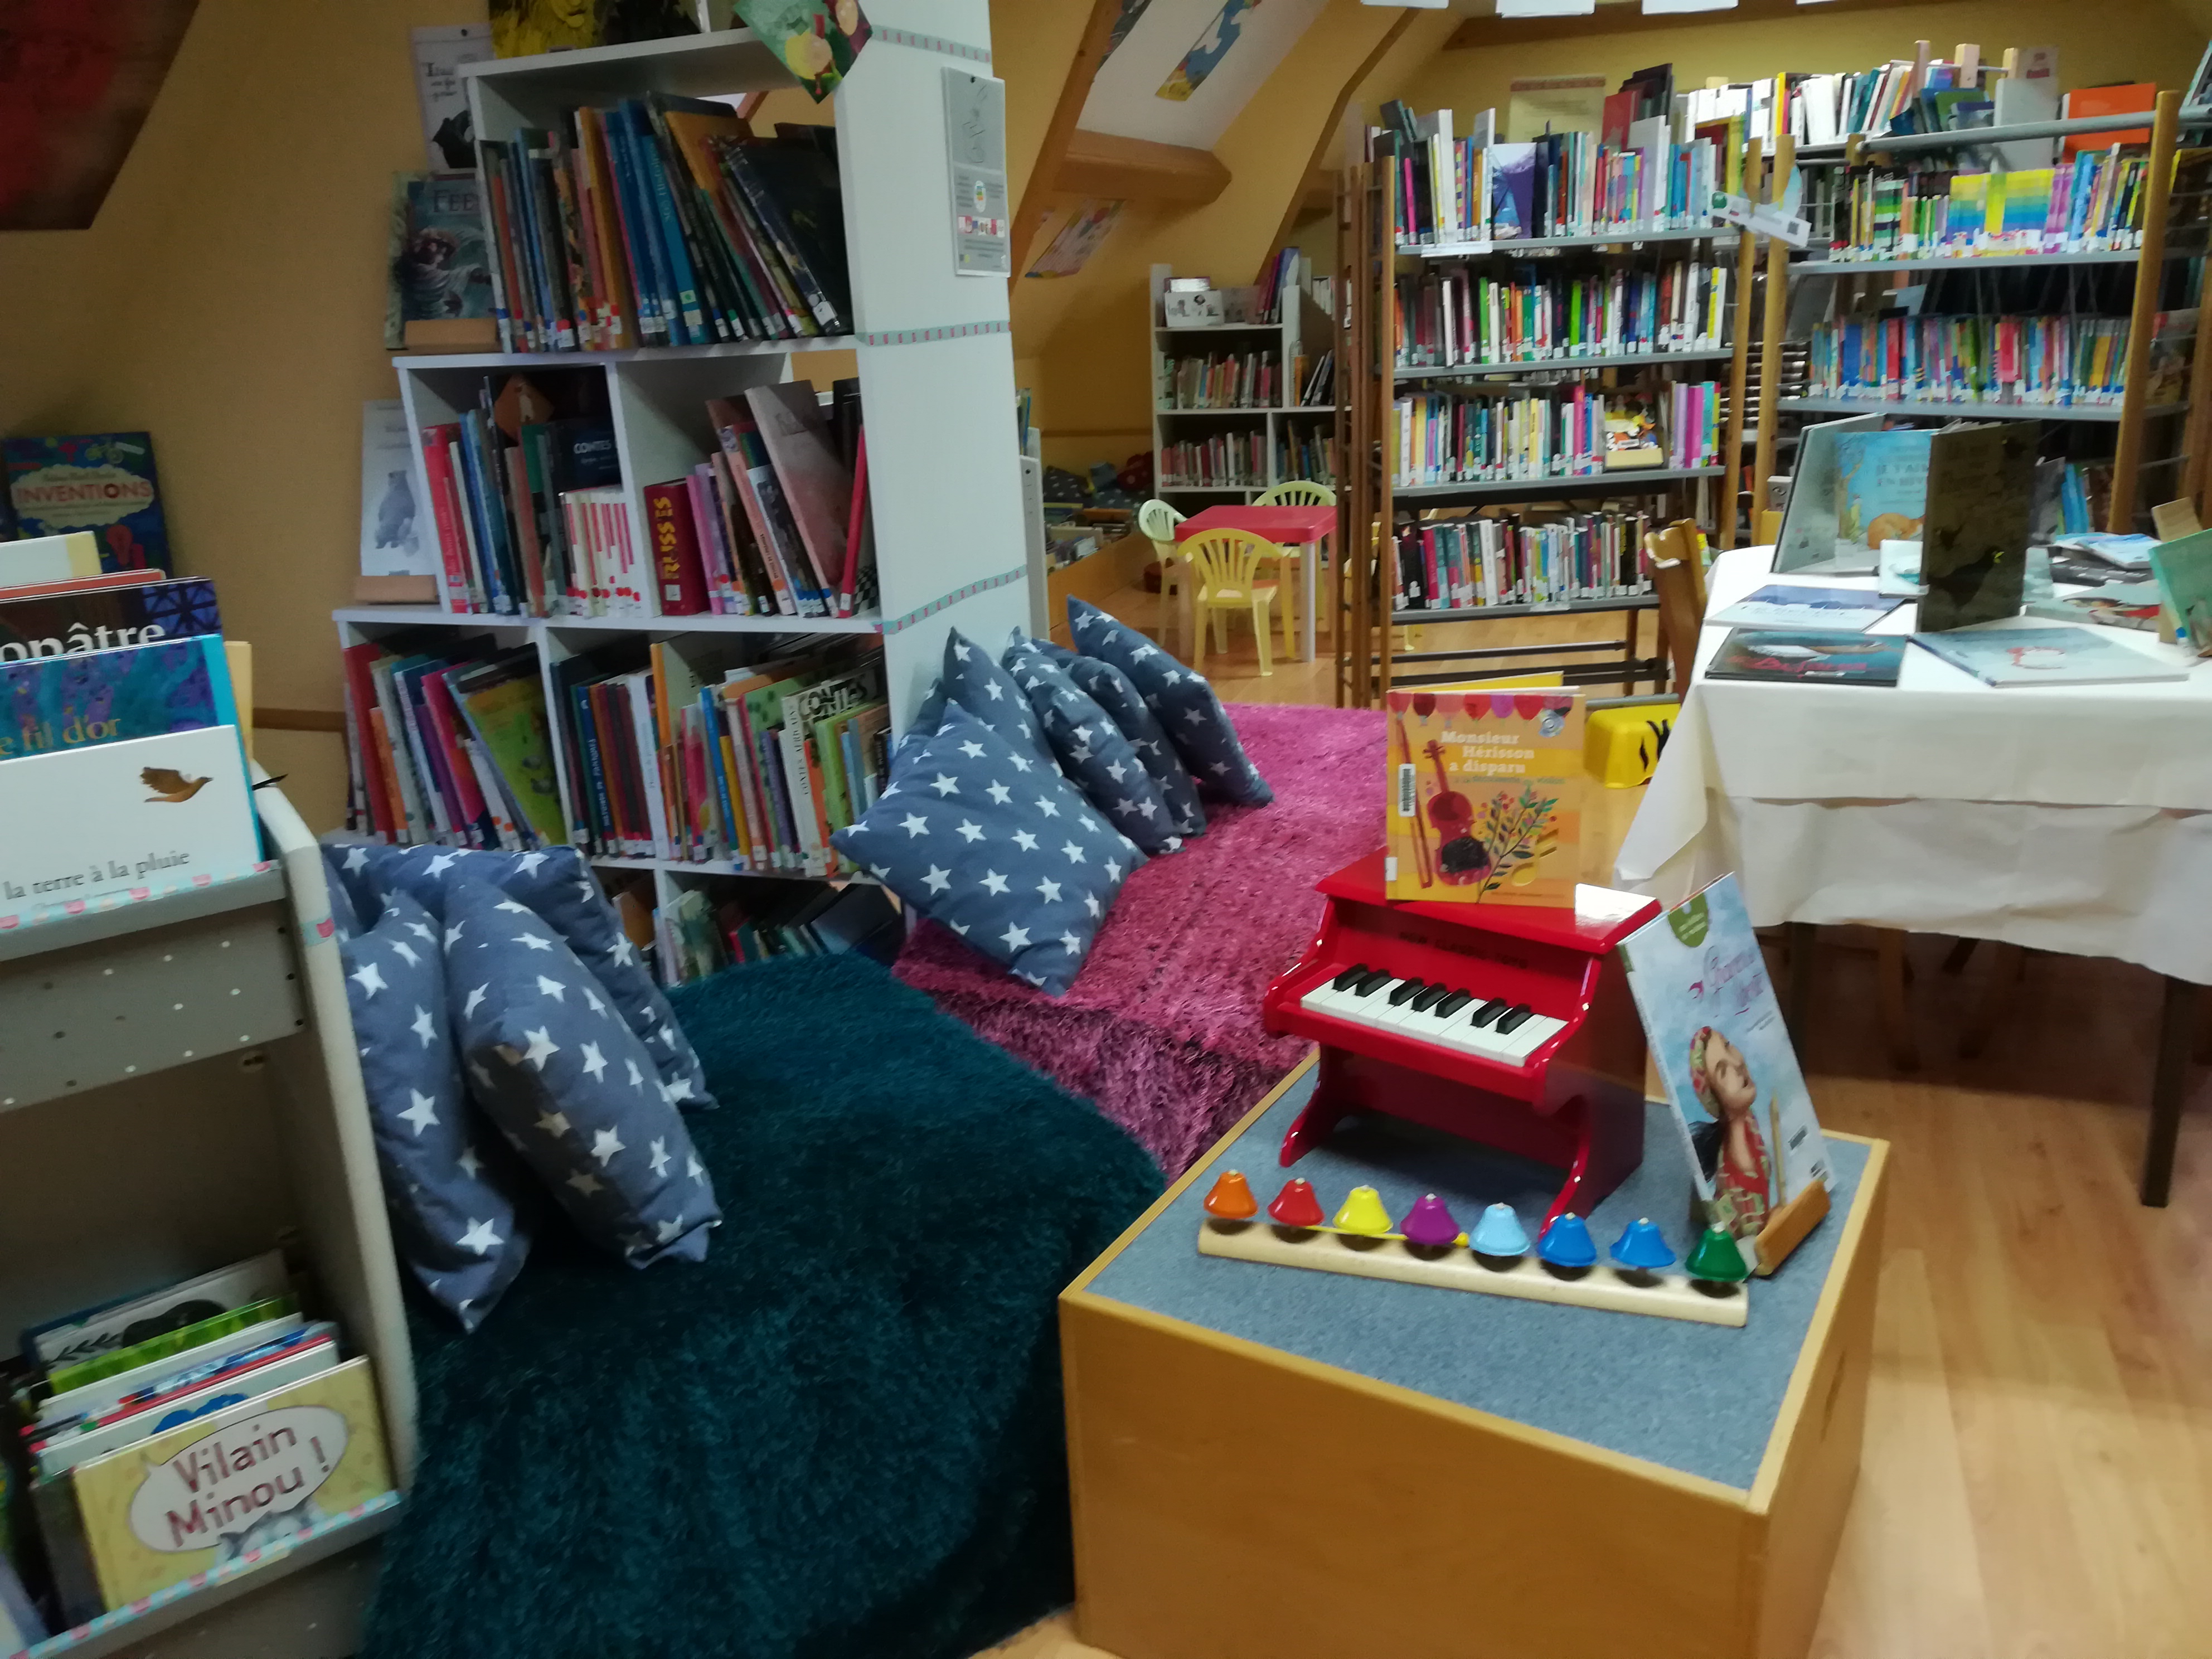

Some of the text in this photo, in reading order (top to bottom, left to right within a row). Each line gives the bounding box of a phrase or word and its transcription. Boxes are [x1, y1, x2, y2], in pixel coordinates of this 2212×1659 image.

[17, 481, 152, 503] INVENTIONS
[62, 716, 121, 744] d'or
[1441, 731, 1520, 744] Monsieur
[1462, 745, 1535, 759] Hérisson
[1449, 759, 1526, 777] a disparu
[32, 874, 85, 894] terre
[107, 860, 130, 879] la
[135, 850, 190, 880] pluie
[172, 1423, 298, 1493] Vilain
[164, 1466, 305, 1548] Minou
